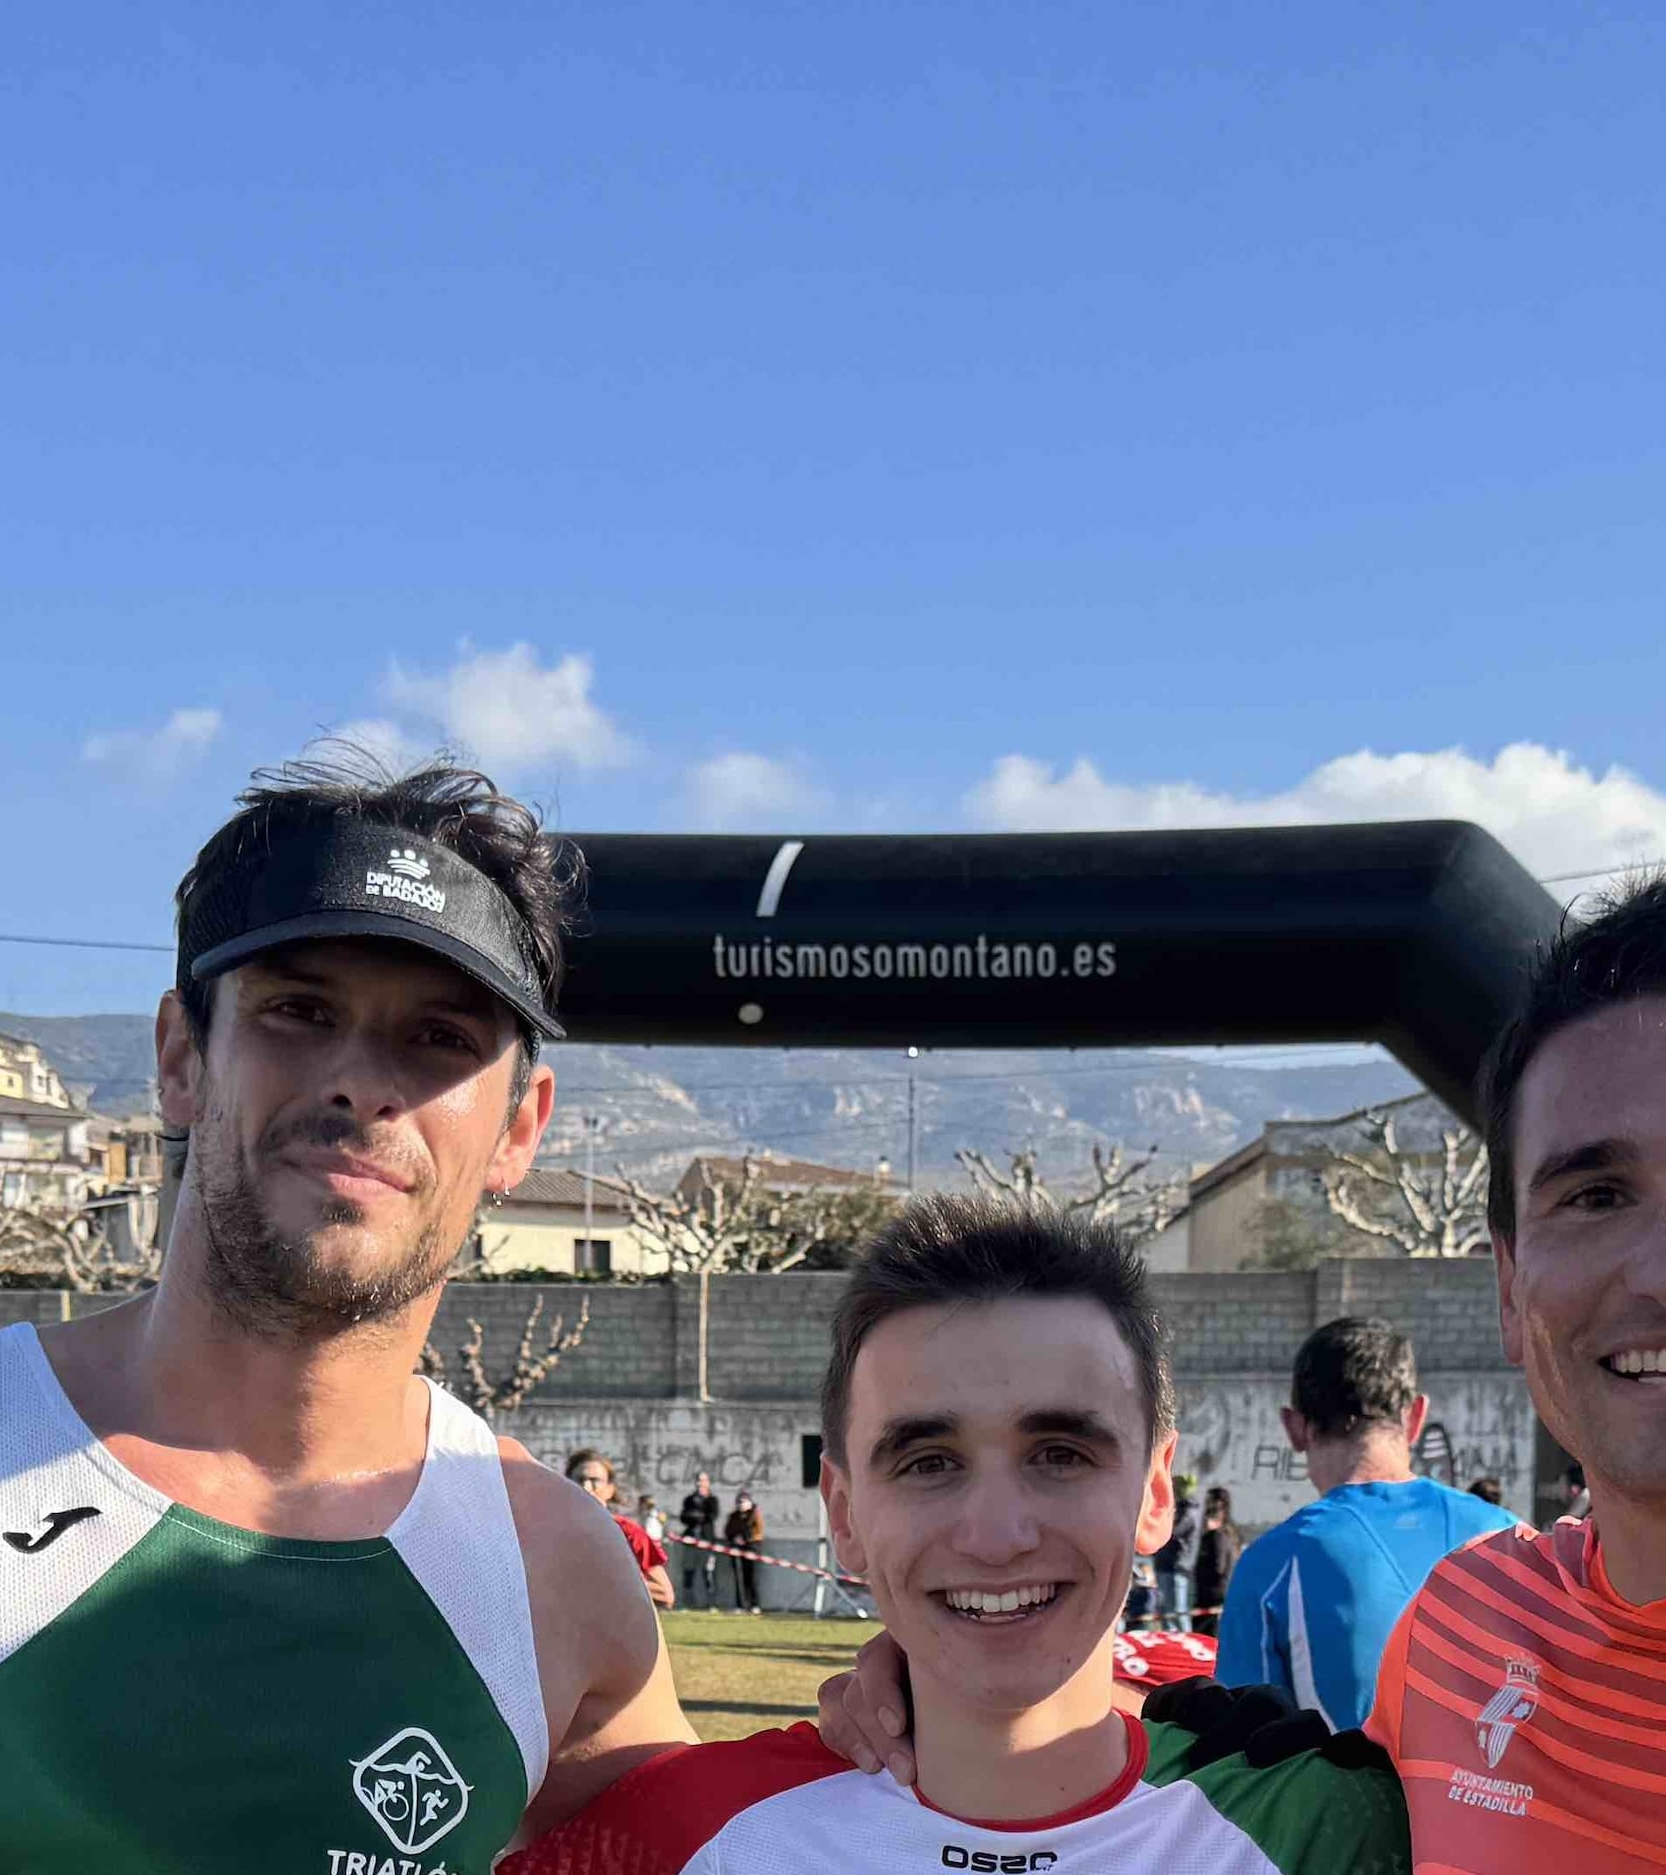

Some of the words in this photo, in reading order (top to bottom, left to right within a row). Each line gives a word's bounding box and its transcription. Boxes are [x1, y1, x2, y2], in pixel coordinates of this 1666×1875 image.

[713, 934, 1116, 978] turismosomontano.es
[1448, 1784, 1465, 1801] DE
[1463, 1788, 1527, 1816] ESTADILLA
[1450, 1767, 1534, 1801] AYUNTAMIENTO
